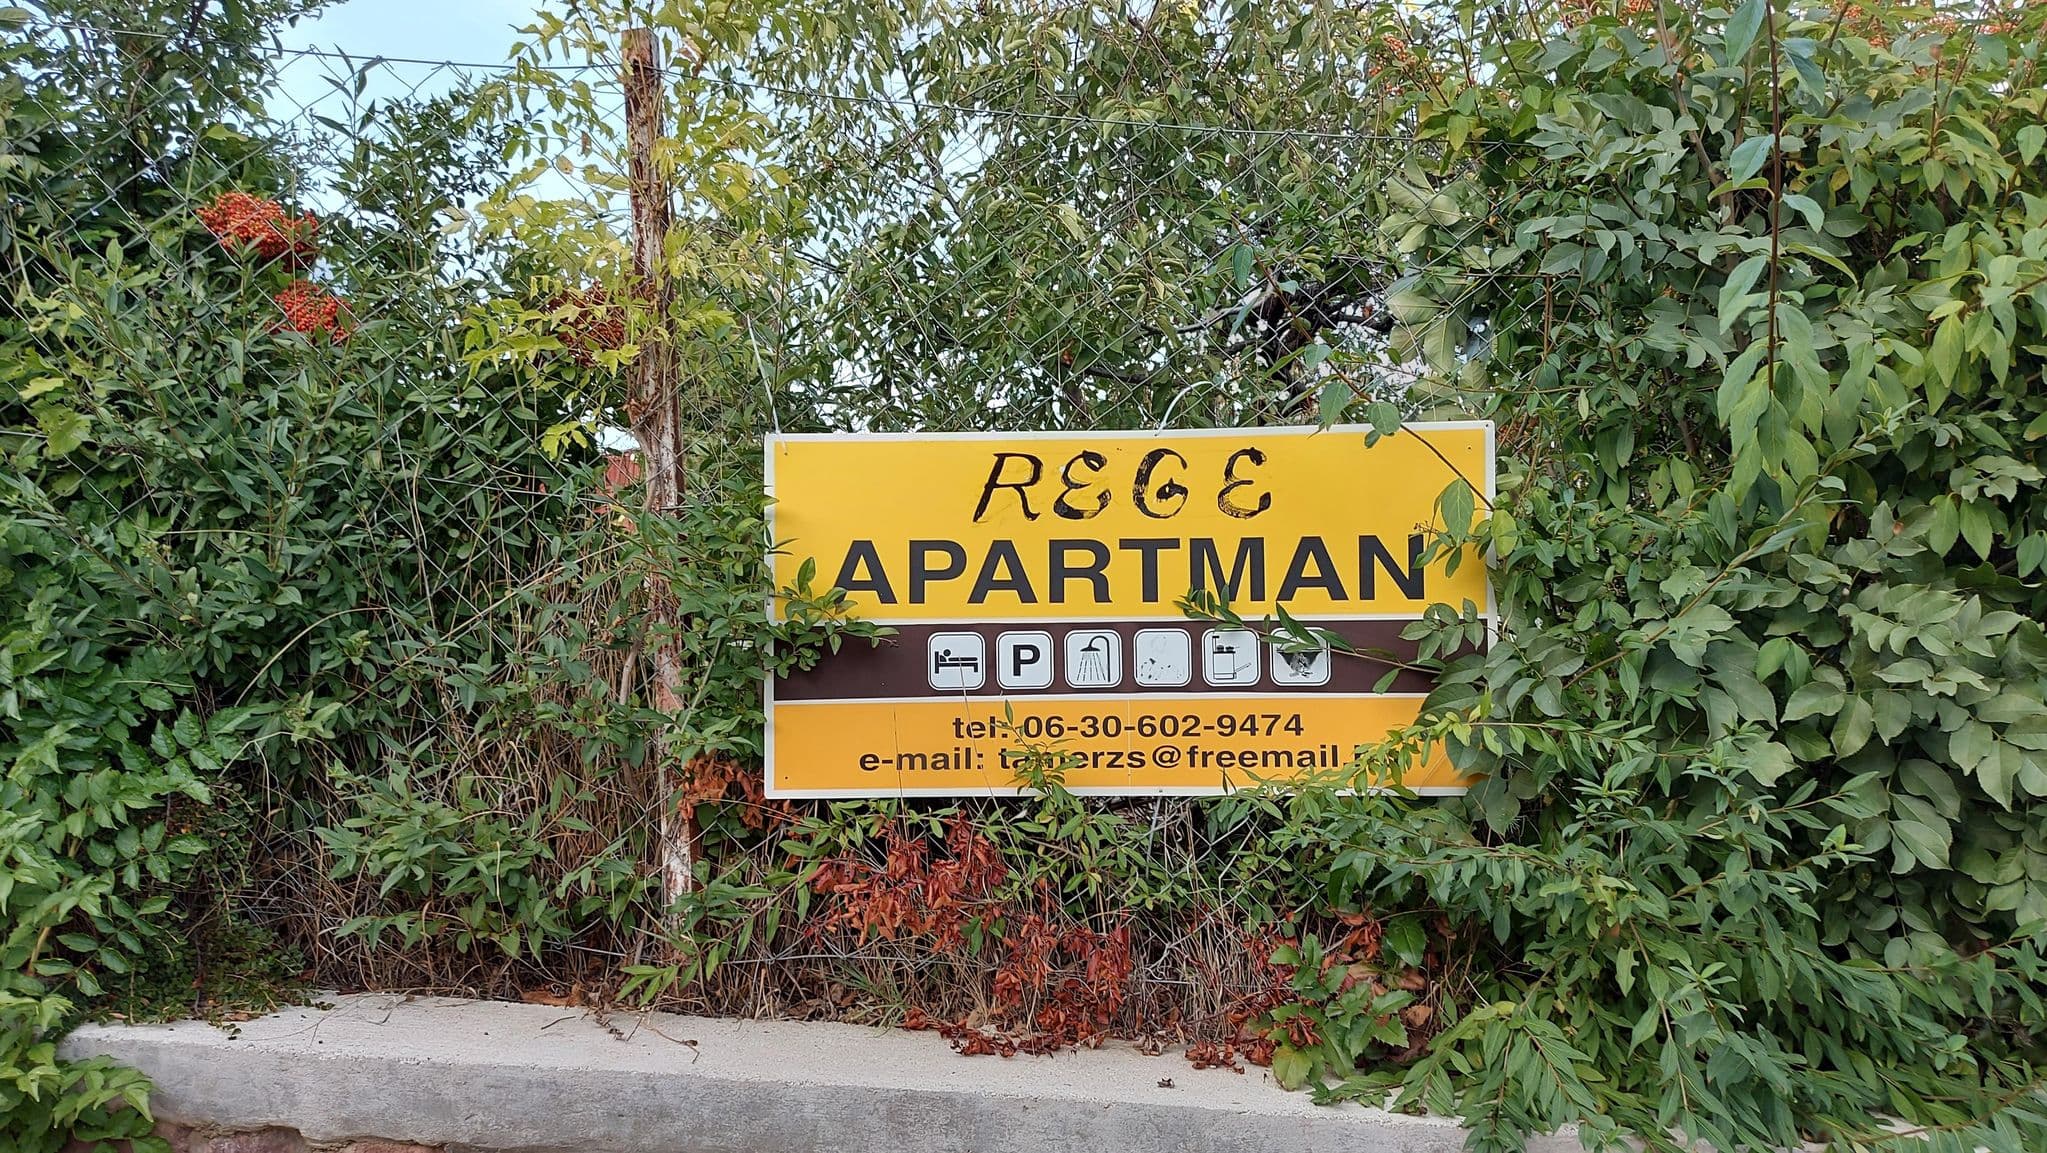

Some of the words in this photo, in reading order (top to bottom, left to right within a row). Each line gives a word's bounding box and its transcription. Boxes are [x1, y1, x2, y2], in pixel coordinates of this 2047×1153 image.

[973, 447, 1272, 523] REGE
[833, 534, 1424, 604] APARTMAN
[1013, 644, 1040, 676] P
[952, 715, 1008, 738] tel.
[1024, 713, 1304, 739] 06-30-602-9474
[859, 747, 984, 771] e-mail:
